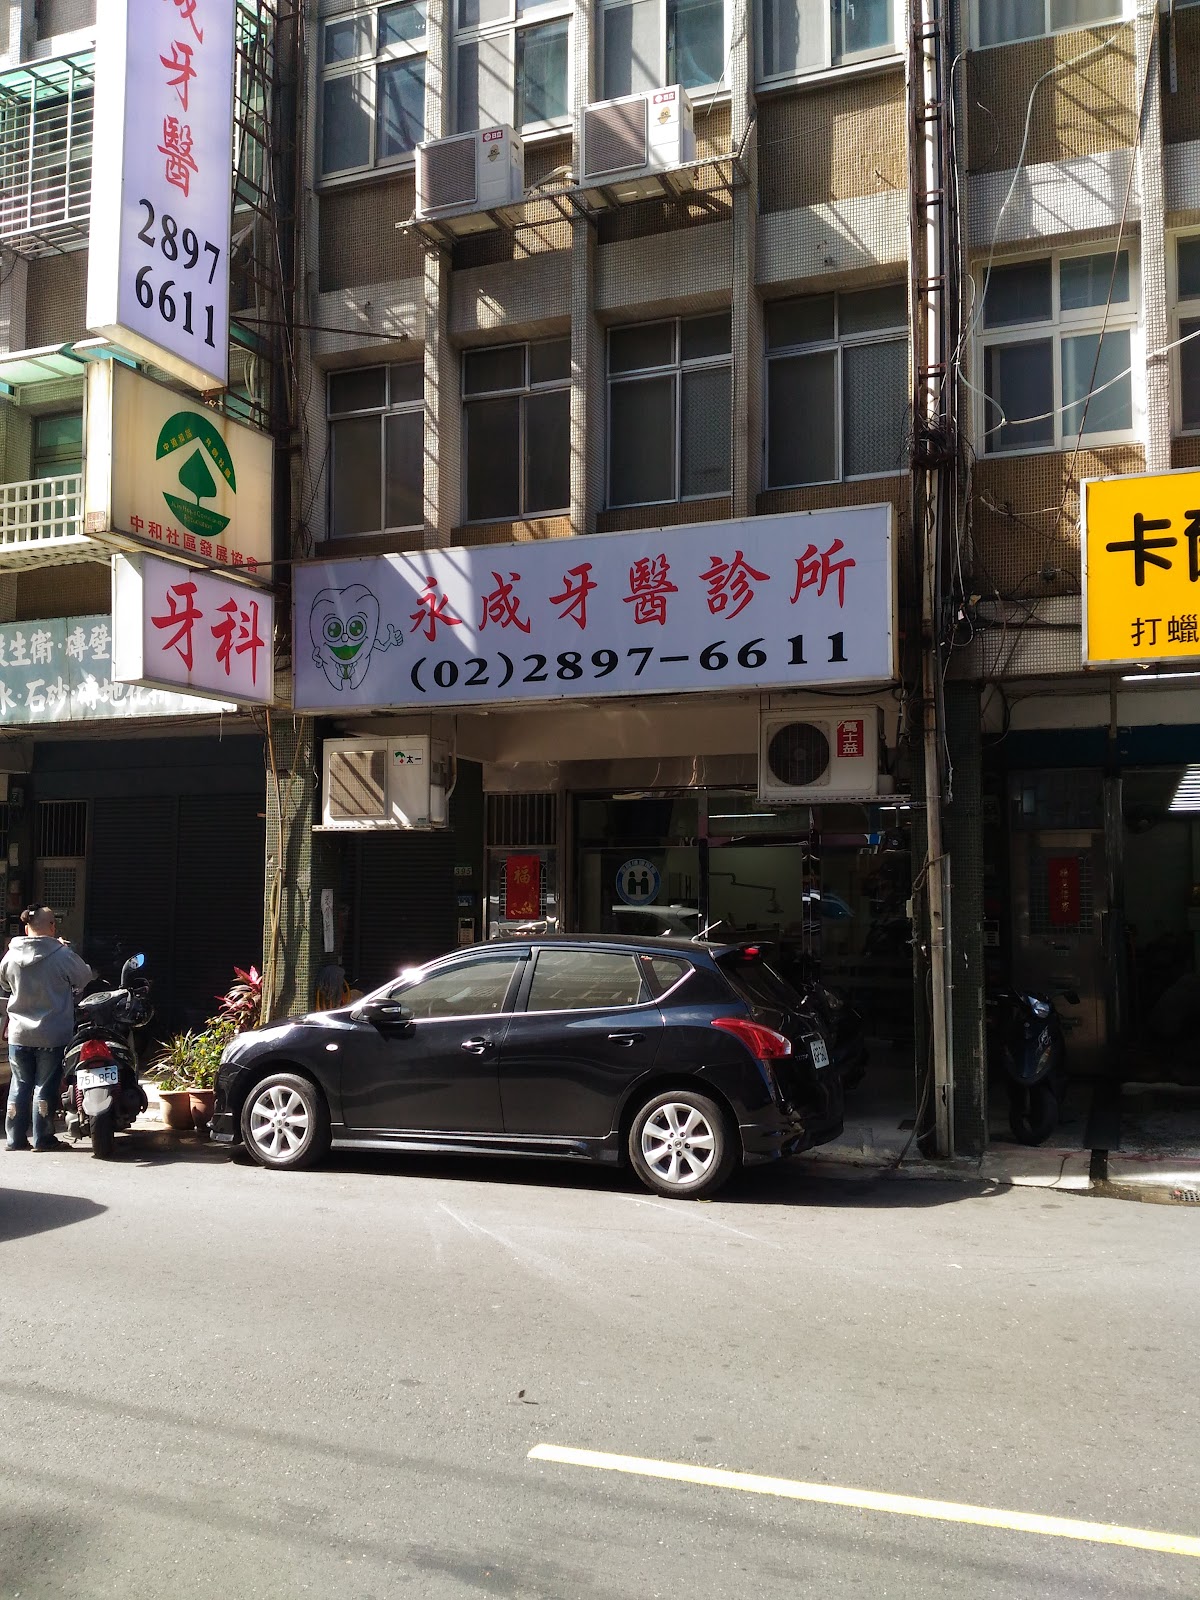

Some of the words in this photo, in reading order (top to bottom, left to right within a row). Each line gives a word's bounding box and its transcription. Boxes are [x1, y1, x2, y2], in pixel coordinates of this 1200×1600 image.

[491, 131, 501, 139] 日立
[137, 198, 221, 285] 2897
[135, 265, 216, 349] 6611
[130, 514, 258, 572] 中和社區發展協會
[409, 538, 856, 643] 永成牙醫診所
[151, 581, 265, 687] 牙科
[1130, 613, 1200, 647] 打蠟
[410, 631, 849, 693] (02)2897-6611
[406, 754, 422, 764] 太一
[842, 722, 858, 754] 萬士益
[455, 867, 471, 876] 395
[513, 865, 531, 885] 福
